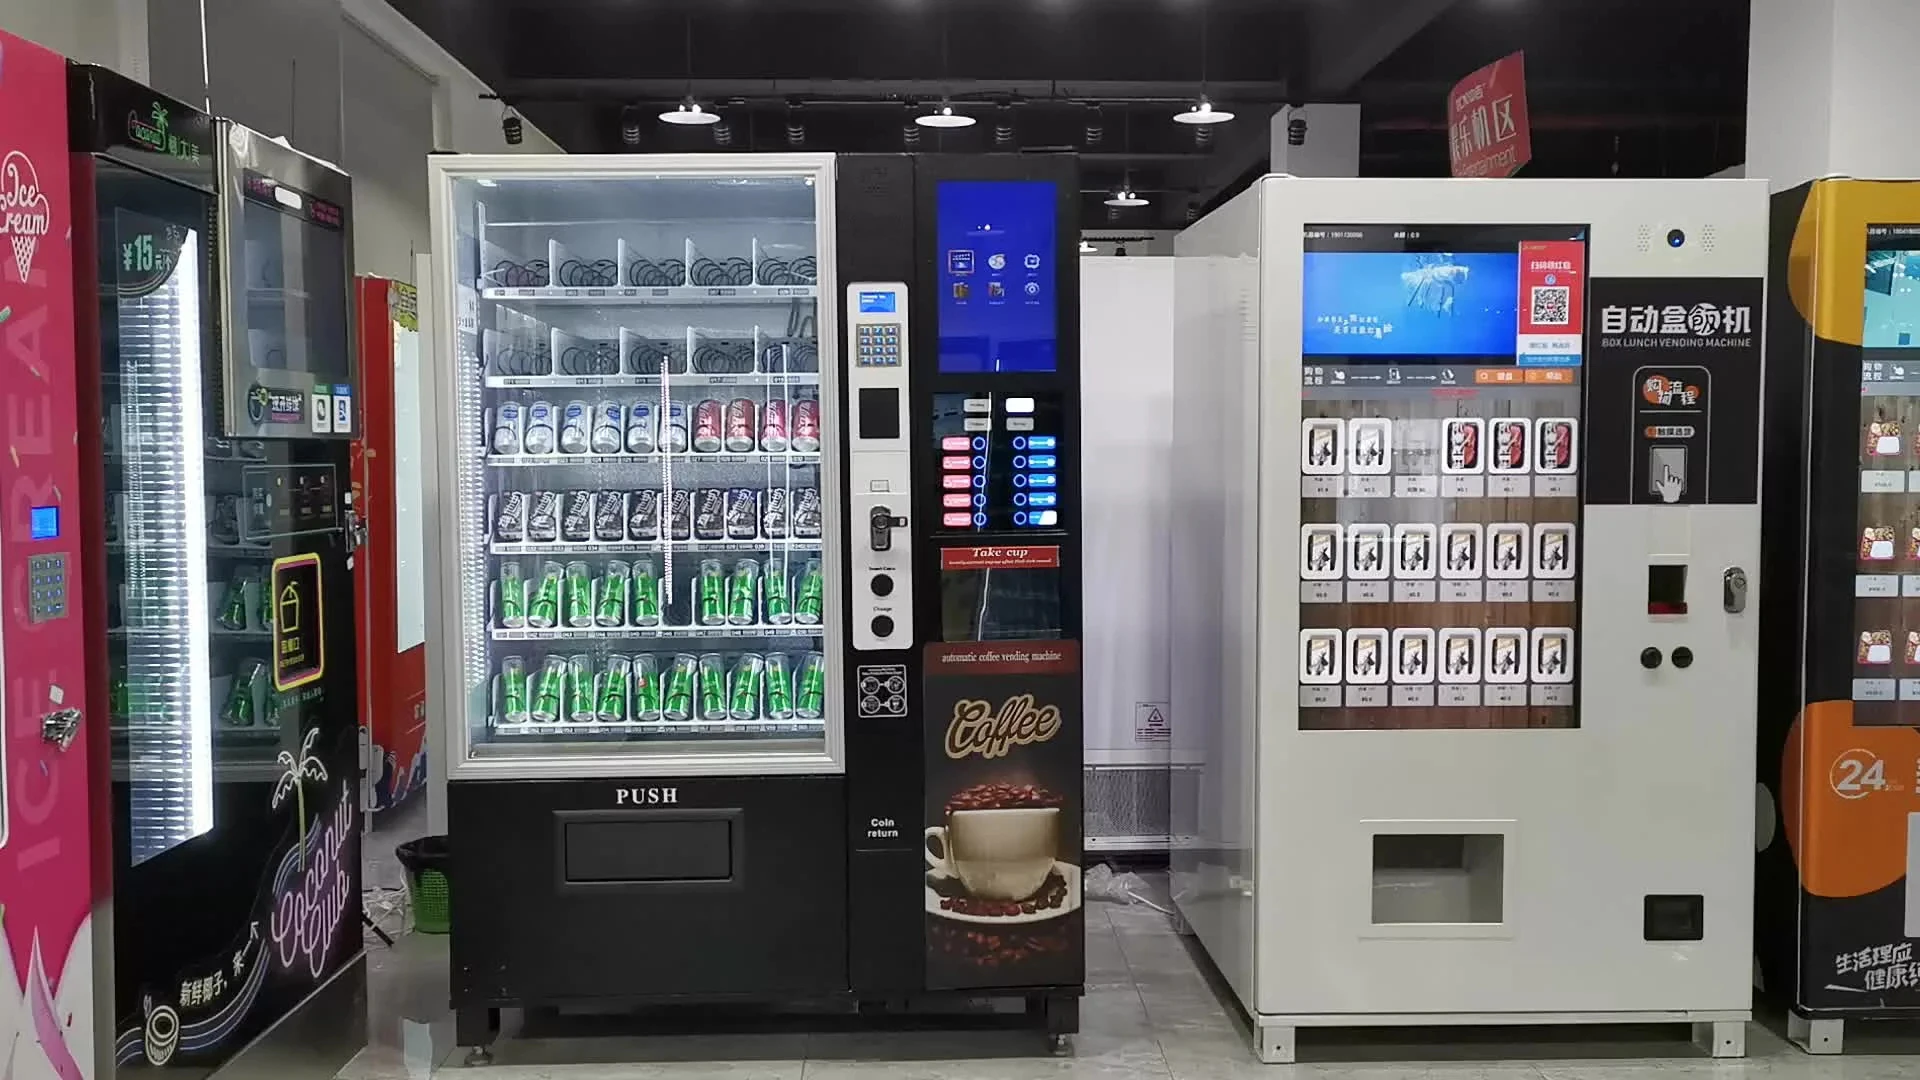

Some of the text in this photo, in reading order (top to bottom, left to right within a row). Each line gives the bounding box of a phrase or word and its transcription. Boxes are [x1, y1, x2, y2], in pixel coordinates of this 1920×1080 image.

[7, 163, 36, 208] Ice
[123, 234, 153, 271] ¥15
[1602, 303, 1751, 336] 自动盒饭机
[1602, 338, 1752, 347] BOX LUNCH VENDING MACHINE
[1646, 378, 1696, 405] 购物流程
[973, 547, 1028, 559] Take cup
[942, 650, 1062, 663] automatic coffee vending machine
[945, 693, 1062, 759] Coffee
[1837, 759, 1886, 790] 24
[615, 787, 678, 805] PUSH
[867, 828, 898, 838] return
[871, 817, 895, 828] Coin
[271, 779, 352, 968] Coconut
[1835, 942, 1912, 975] 生活理应
